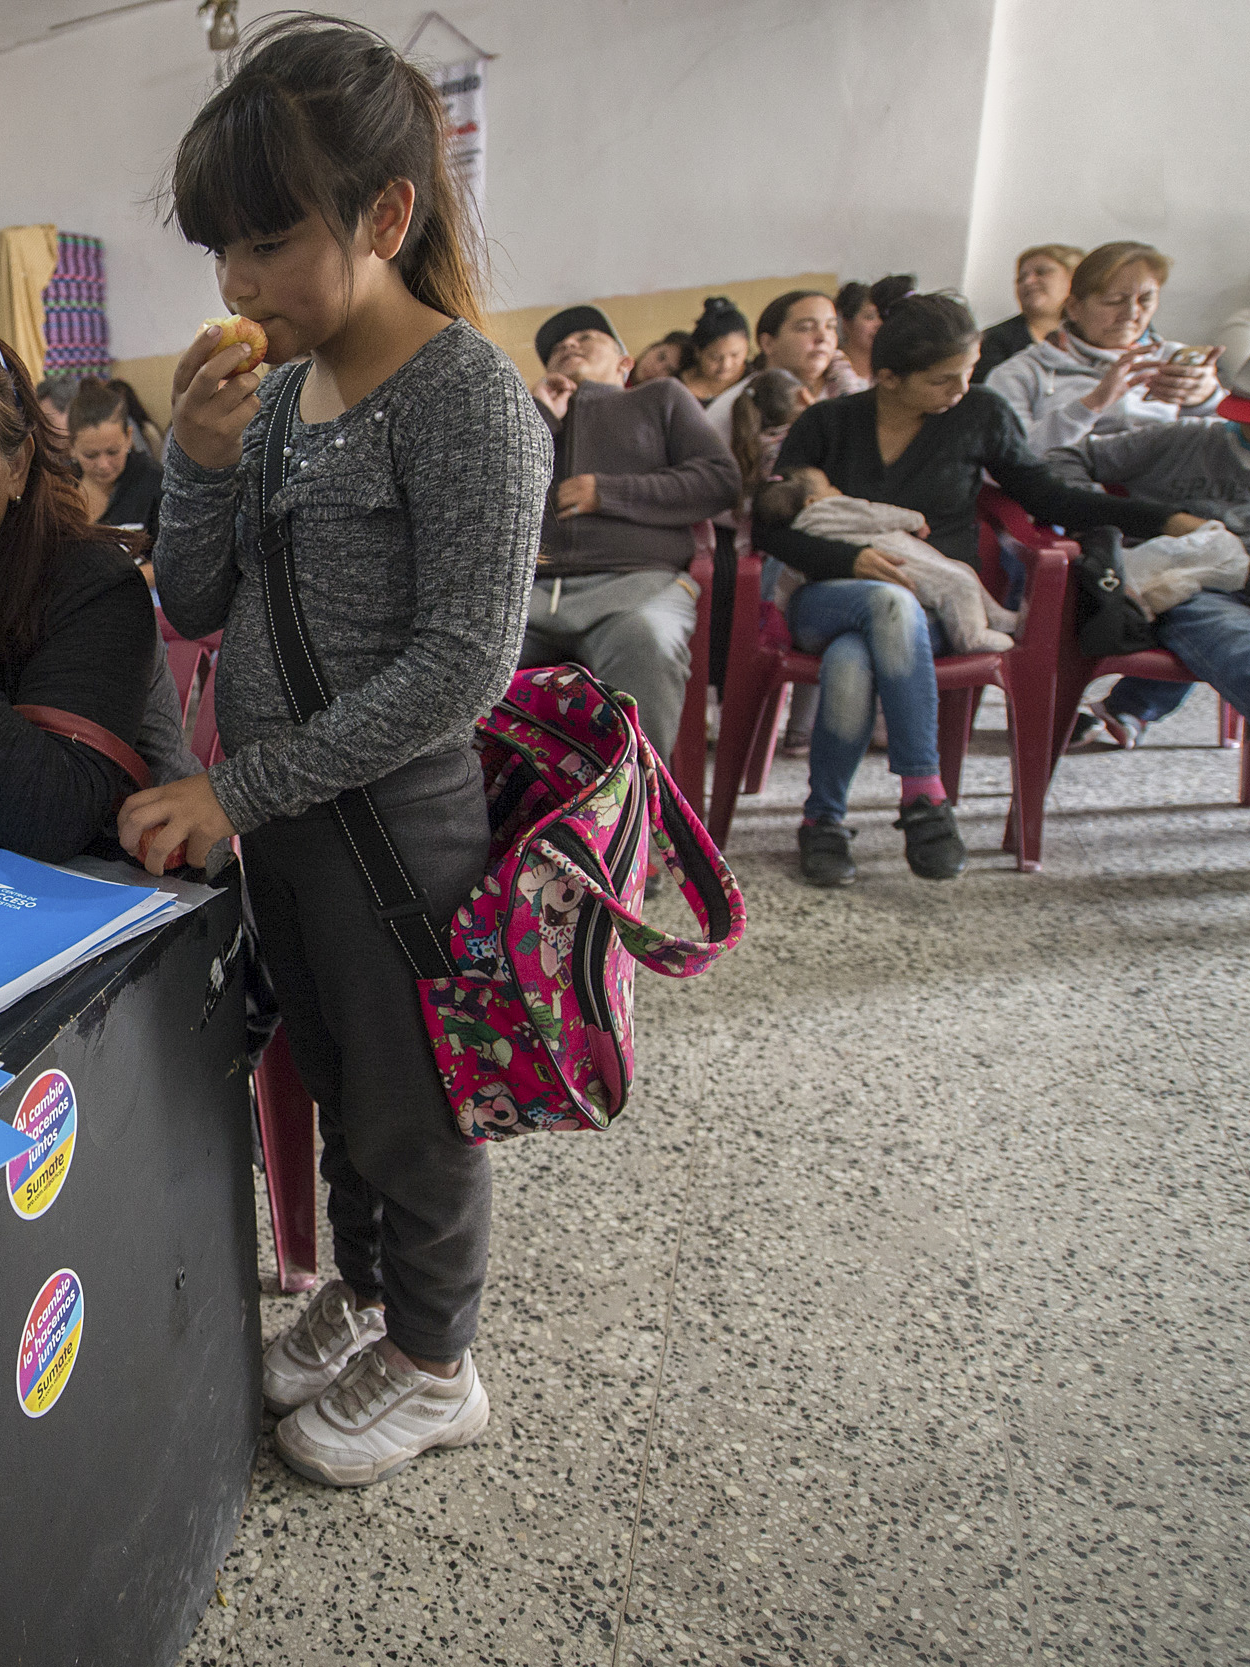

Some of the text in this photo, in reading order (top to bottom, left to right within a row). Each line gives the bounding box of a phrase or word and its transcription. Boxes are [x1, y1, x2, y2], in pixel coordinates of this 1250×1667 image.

[1, 888, 27, 899] CENTRO
[17, 1082, 64, 1132] Al cambio
[28, 1128, 58, 1170] juntos
[26, 1153, 64, 1201] Sumate
[23, 1289, 76, 1369] lo hacemos
[25, 1278, 70, 1348] Al cambio
[37, 1342, 73, 1400] Sumate
[38, 1322, 66, 1371] juntos
[418, 1403, 447, 1417] Topper
